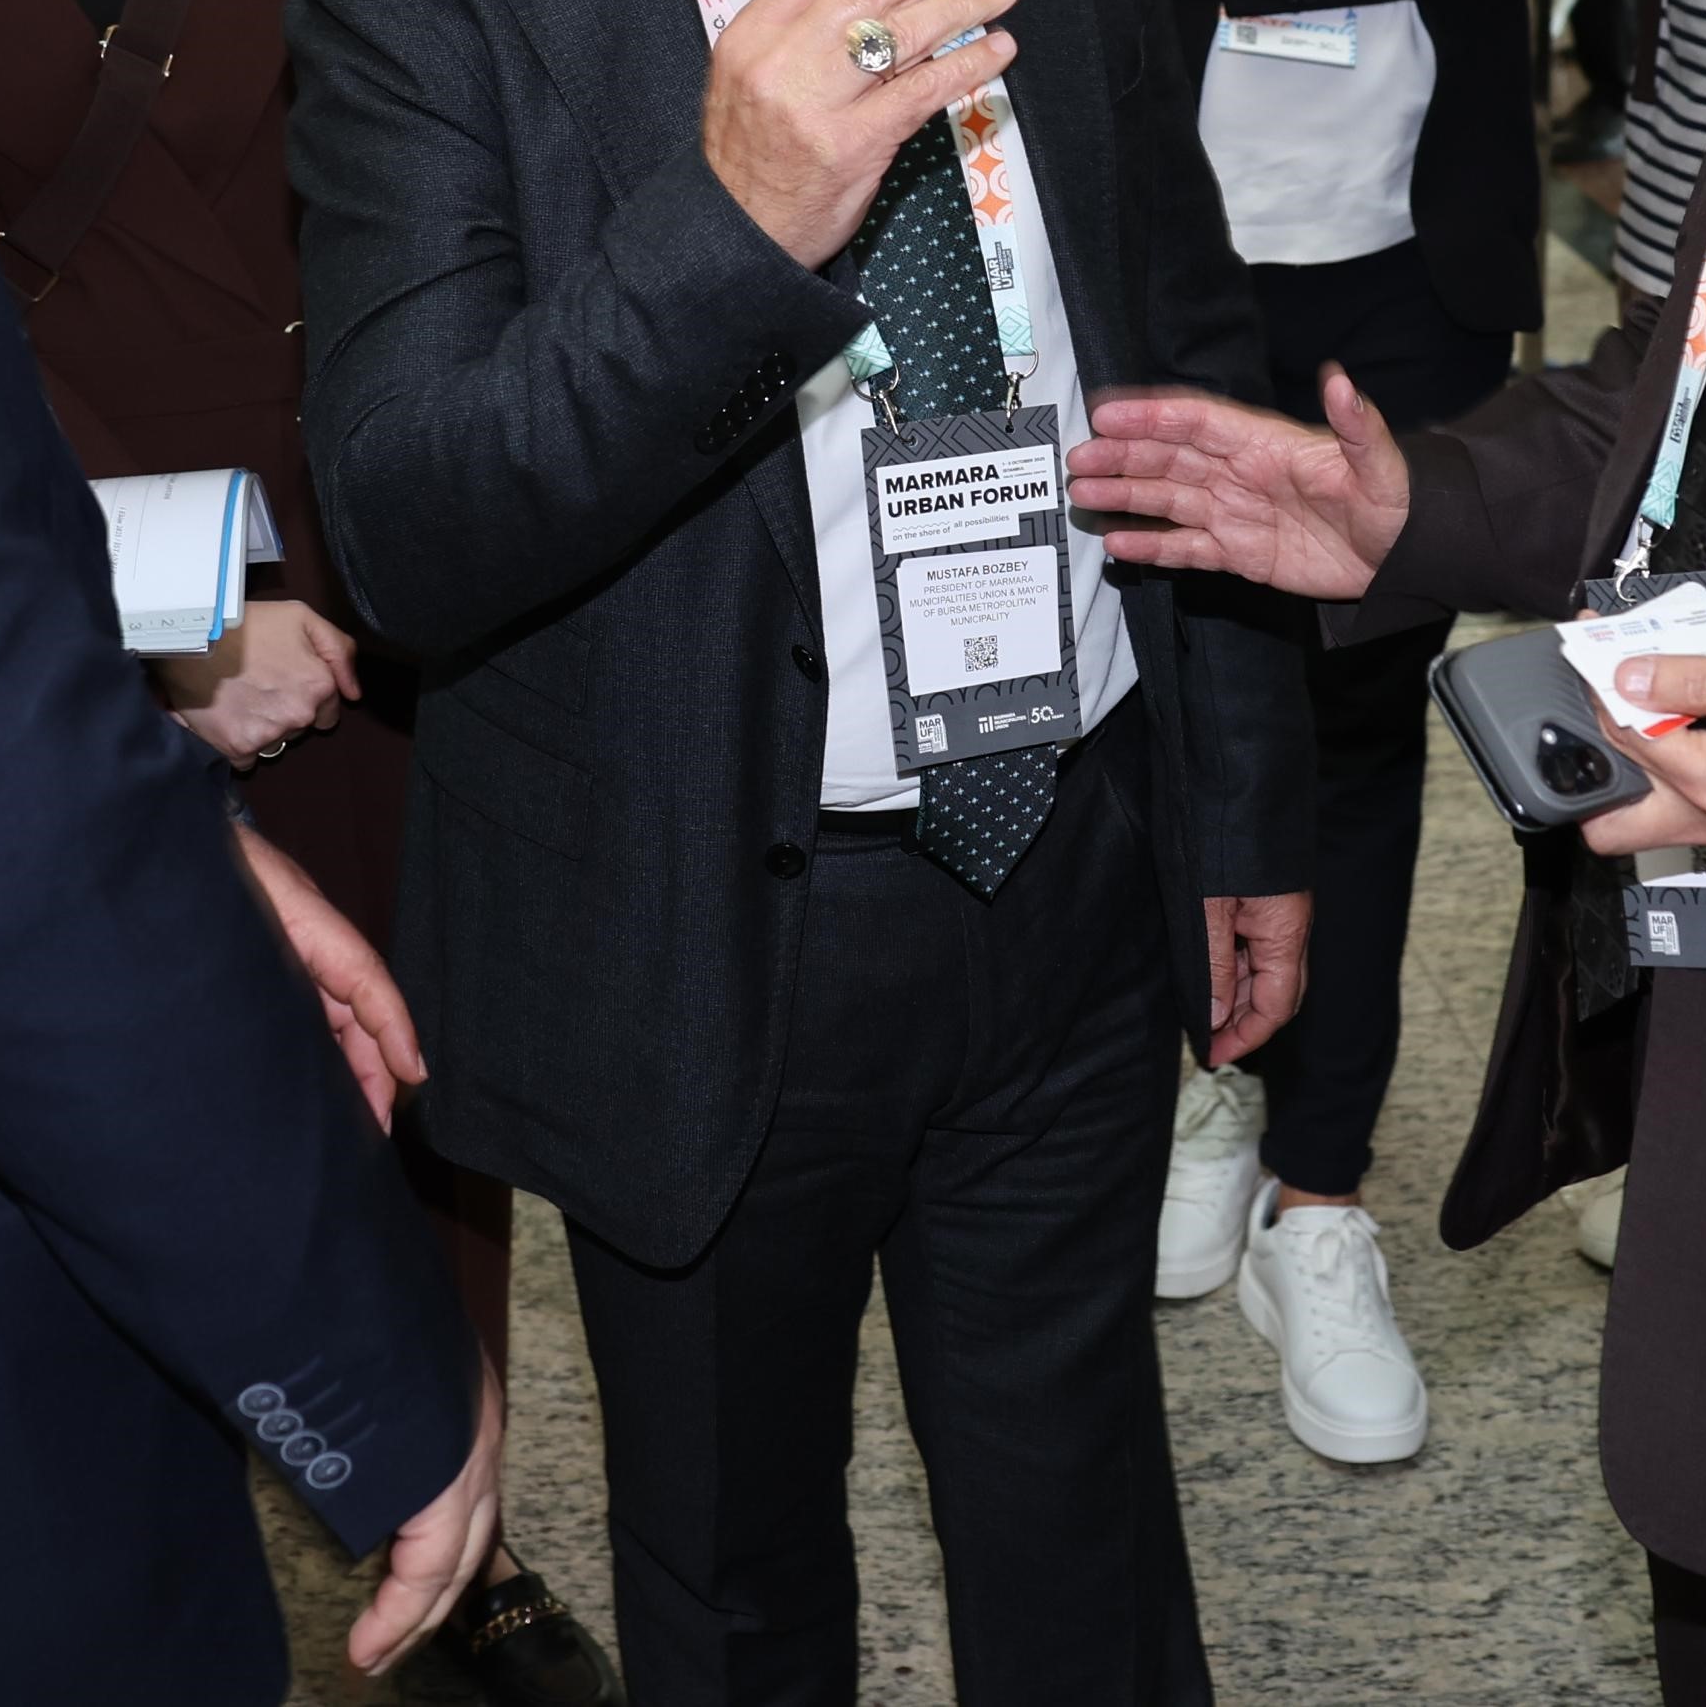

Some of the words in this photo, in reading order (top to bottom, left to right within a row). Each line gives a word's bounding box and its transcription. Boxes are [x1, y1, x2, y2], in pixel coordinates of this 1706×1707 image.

[989, 259, 1002, 290] MAR
[1000, 270, 1012, 288] UF
[885, 464, 1000, 495] MARMARA
[887, 492, 964, 518] URBAN
[971, 480, 1049, 507] FORUM
[953, 520, 963, 528] all
[965, 514, 1010, 528] possibilities
[893, 533, 903, 542] on
[905, 531, 917, 540] the
[919, 528, 941, 538] shore
[943, 525, 951, 534] of
[927, 566, 980, 581] MUSTAFA
[982, 560, 1029, 575] BOZBEY
[923, 581, 972, 594] PRESIDENT
[975, 580, 987, 588] OF
[989, 575, 1034, 587] MARMARA
[909, 592, 977, 608] MUNICIPALITIES
[979, 589, 1008, 600] UNION
[1010, 588, 1016, 596] &
[1018, 584, 1049, 596] MAYOR
[923, 609, 935, 618] OF
[937, 605, 967, 616] BURSA
[969, 597, 1036, 612] METROPOLITAN
[950, 612, 1010, 626] MUNICIPALITY
[919, 718, 941, 728] MAR
[920, 727, 933, 738] UF
[1652, 915, 1673, 925] MAR
[1653, 925, 1664, 934] UF
